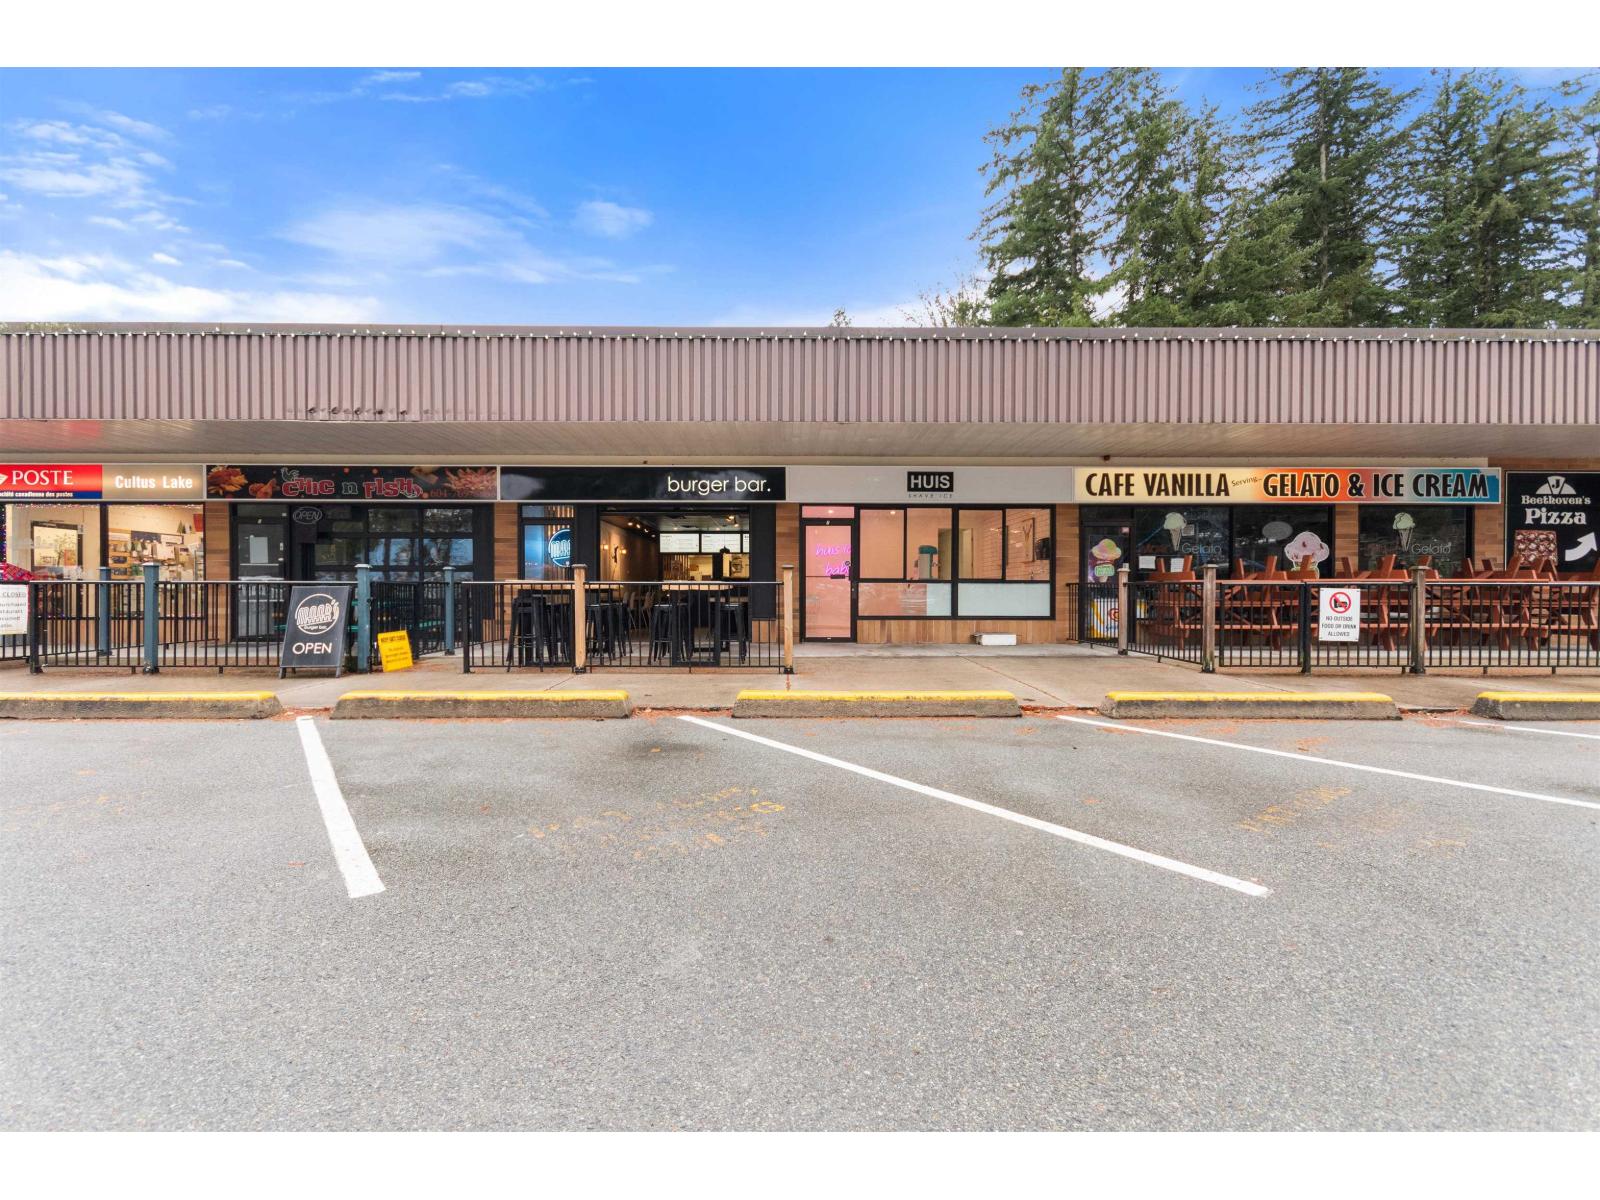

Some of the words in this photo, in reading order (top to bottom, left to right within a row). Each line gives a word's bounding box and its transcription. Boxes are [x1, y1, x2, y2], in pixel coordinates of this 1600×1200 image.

[12, 470, 73, 485] POSTE
[115, 475, 156, 489] Cultus
[162, 475, 193, 489] Lake
[910, 475, 950, 488] HUIS
[667, 476, 729, 495] burger
[735, 476, 771, 492] bar.
[1085, 473, 1135, 497] CAFE
[1143, 473, 1230, 497] VANILLA
[1262, 473, 1340, 498] GELATO
[1347, 473, 1367, 498] &
[1373, 473, 1404, 497] ICE
[1412, 473, 1489, 498] CREAM
[1521, 495, 1591, 504] Beethoven's
[294, 511, 320, 520] OPEN
[1525, 507, 1587, 524] Pizza
[1182, 543, 1221, 554] Gelato
[1411, 543, 1451, 554] Gelato
[292, 642, 332, 654] OPEN
